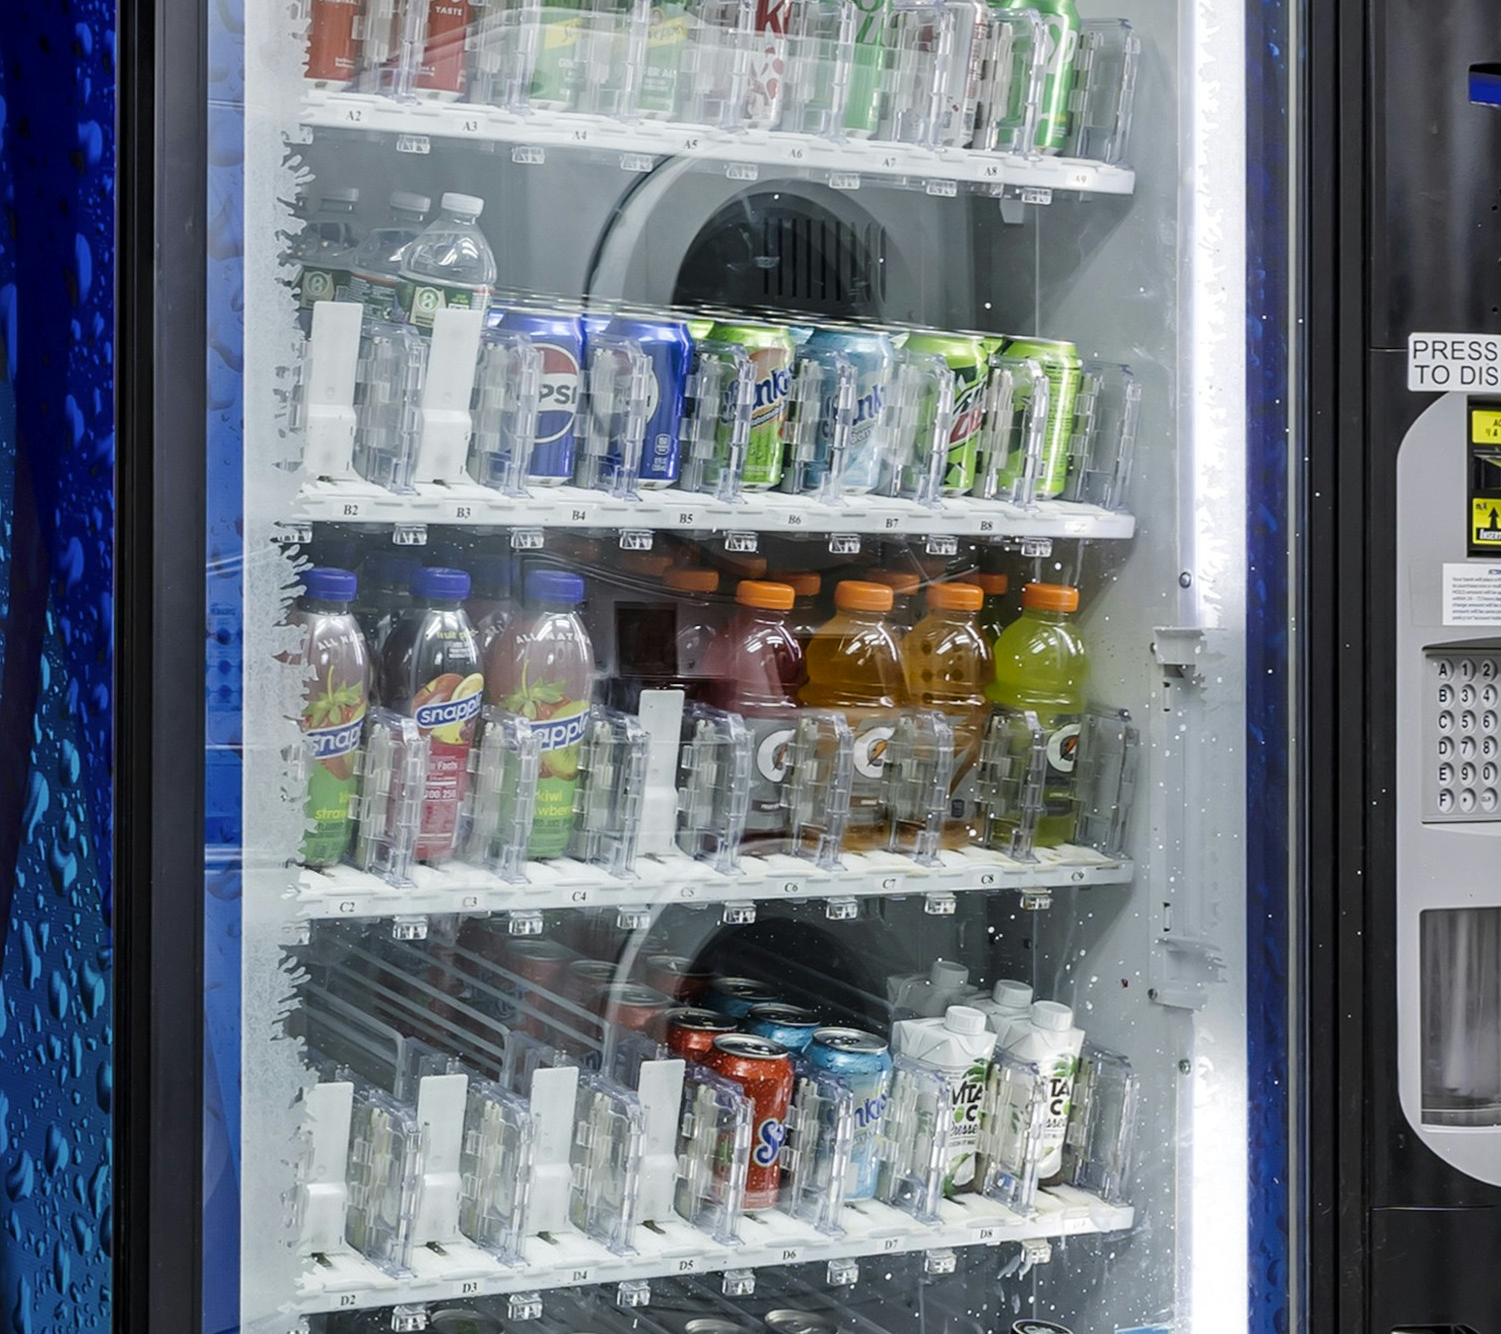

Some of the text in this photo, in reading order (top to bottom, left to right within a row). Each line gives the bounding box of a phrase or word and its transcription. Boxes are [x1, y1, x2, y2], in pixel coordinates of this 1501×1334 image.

[1413, 340, 1498, 361] PRESS
[1414, 365, 1450, 384] TO
[1439, 689, 1489, 702] B 3 4
[1439, 715, 1468, 729] C 5
[1439, 741, 1447, 755] D
